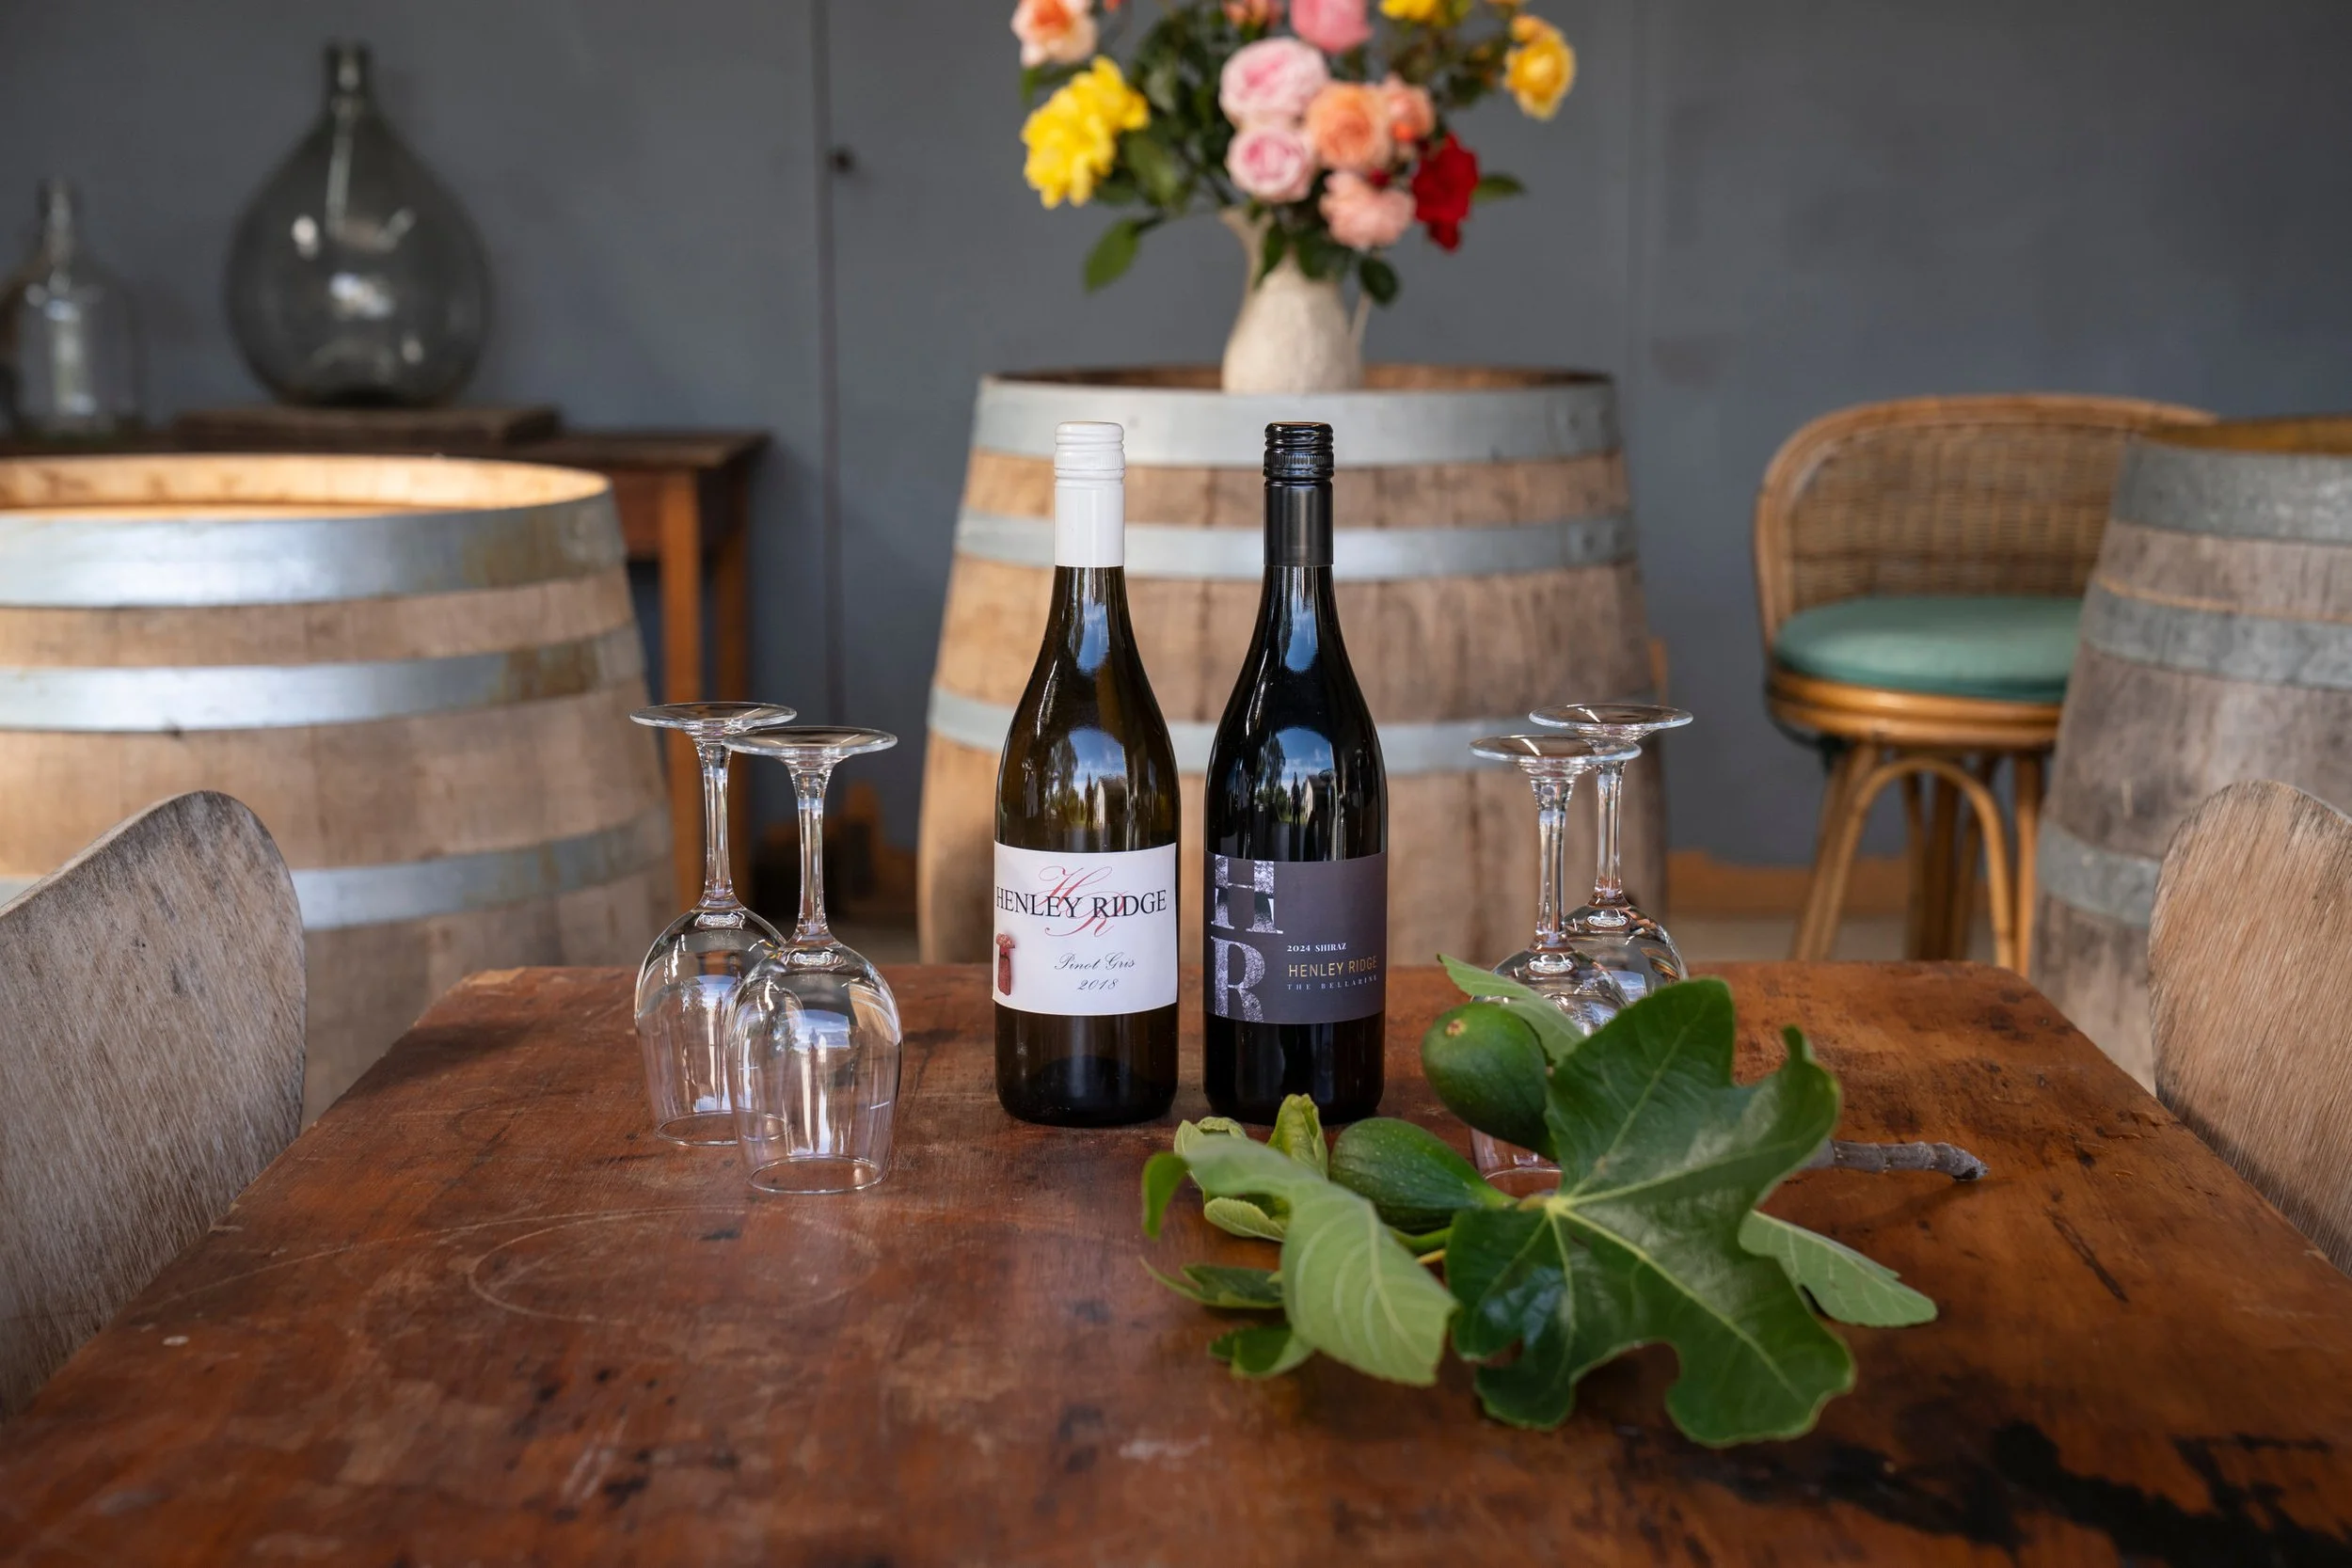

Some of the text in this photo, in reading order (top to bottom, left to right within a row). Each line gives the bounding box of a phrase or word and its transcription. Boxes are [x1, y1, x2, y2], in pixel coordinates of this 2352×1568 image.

[995, 886, 1168, 918] HENLEY RIDGE
[1286, 942, 1347, 953] 2024 SHIRAZ
[1054, 951, 1136, 971] Pinot Gris
[1288, 956, 1377, 977] HENLEY RIDGE
[1076, 977, 1120, 990] 2018
